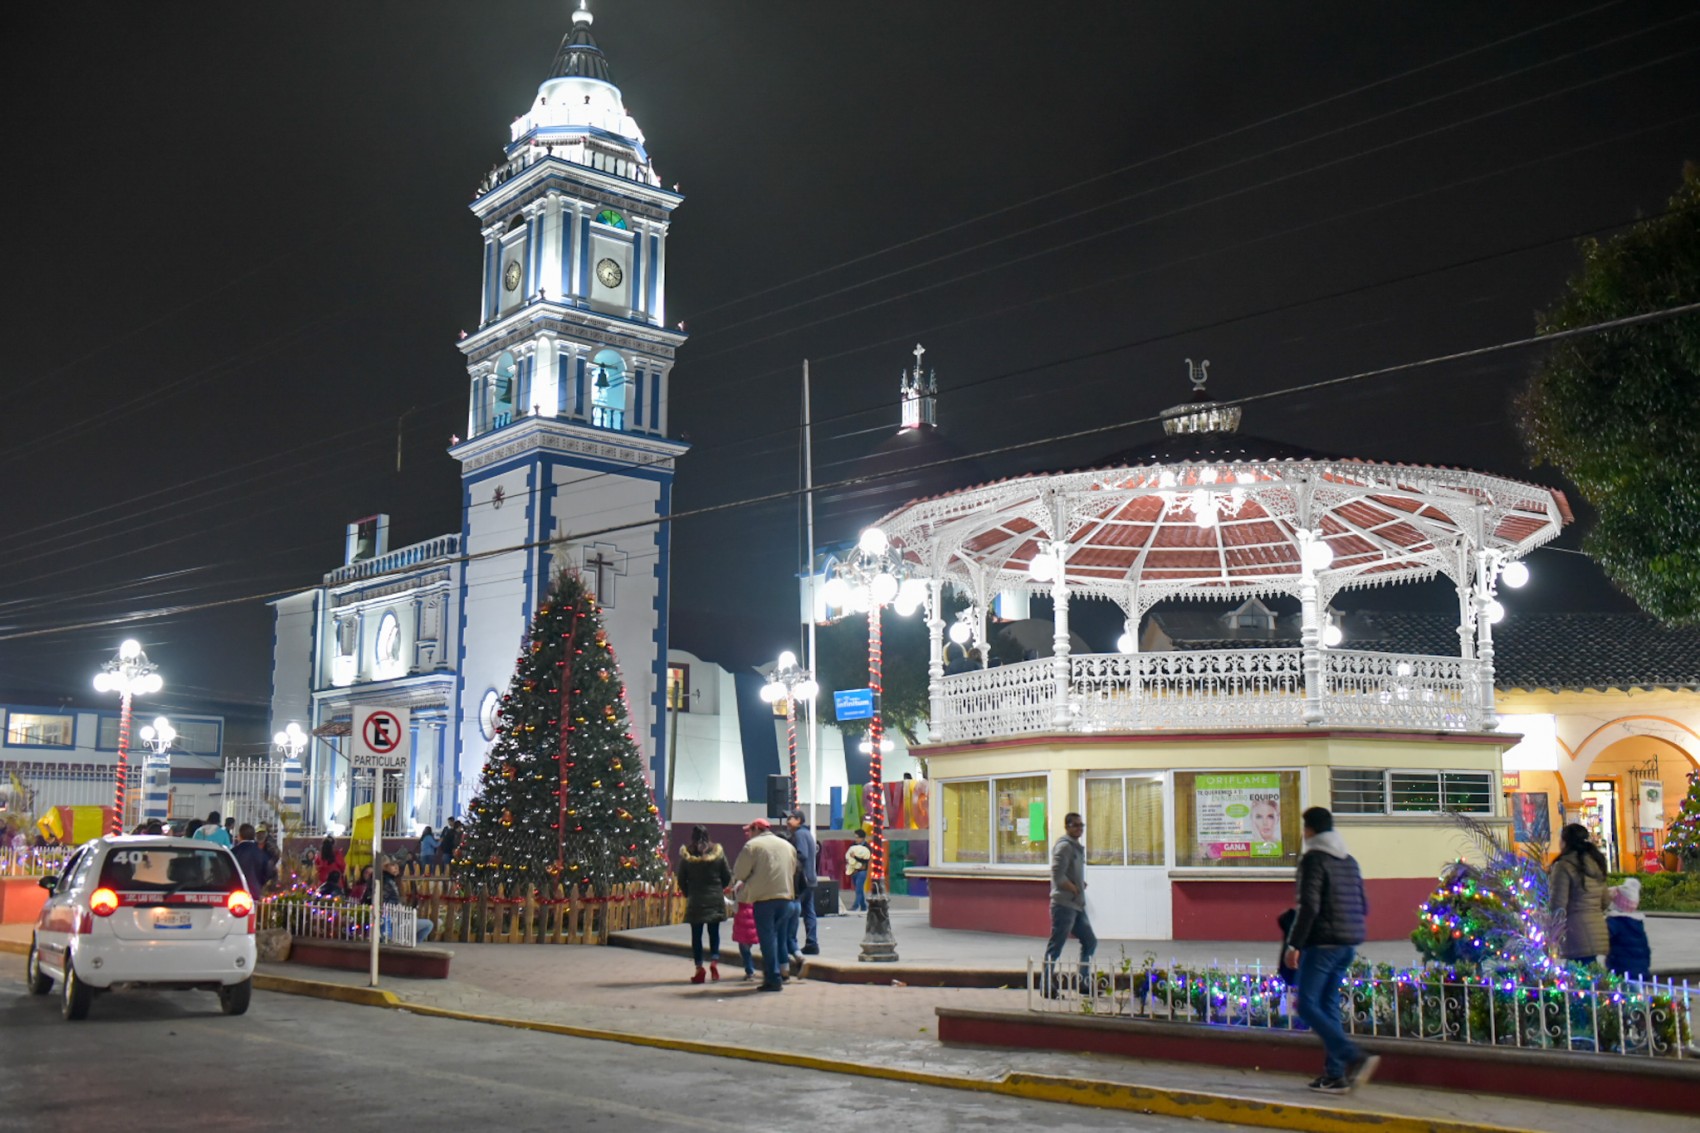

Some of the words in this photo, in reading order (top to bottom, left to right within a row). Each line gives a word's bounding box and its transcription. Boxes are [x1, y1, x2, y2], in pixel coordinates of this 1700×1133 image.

[354, 755, 407, 768] PARTICULAR
[1207, 776, 1268, 785] ORIFLAME
[113, 851, 143, 864] 40
[200, 894, 208, 903] LAS
